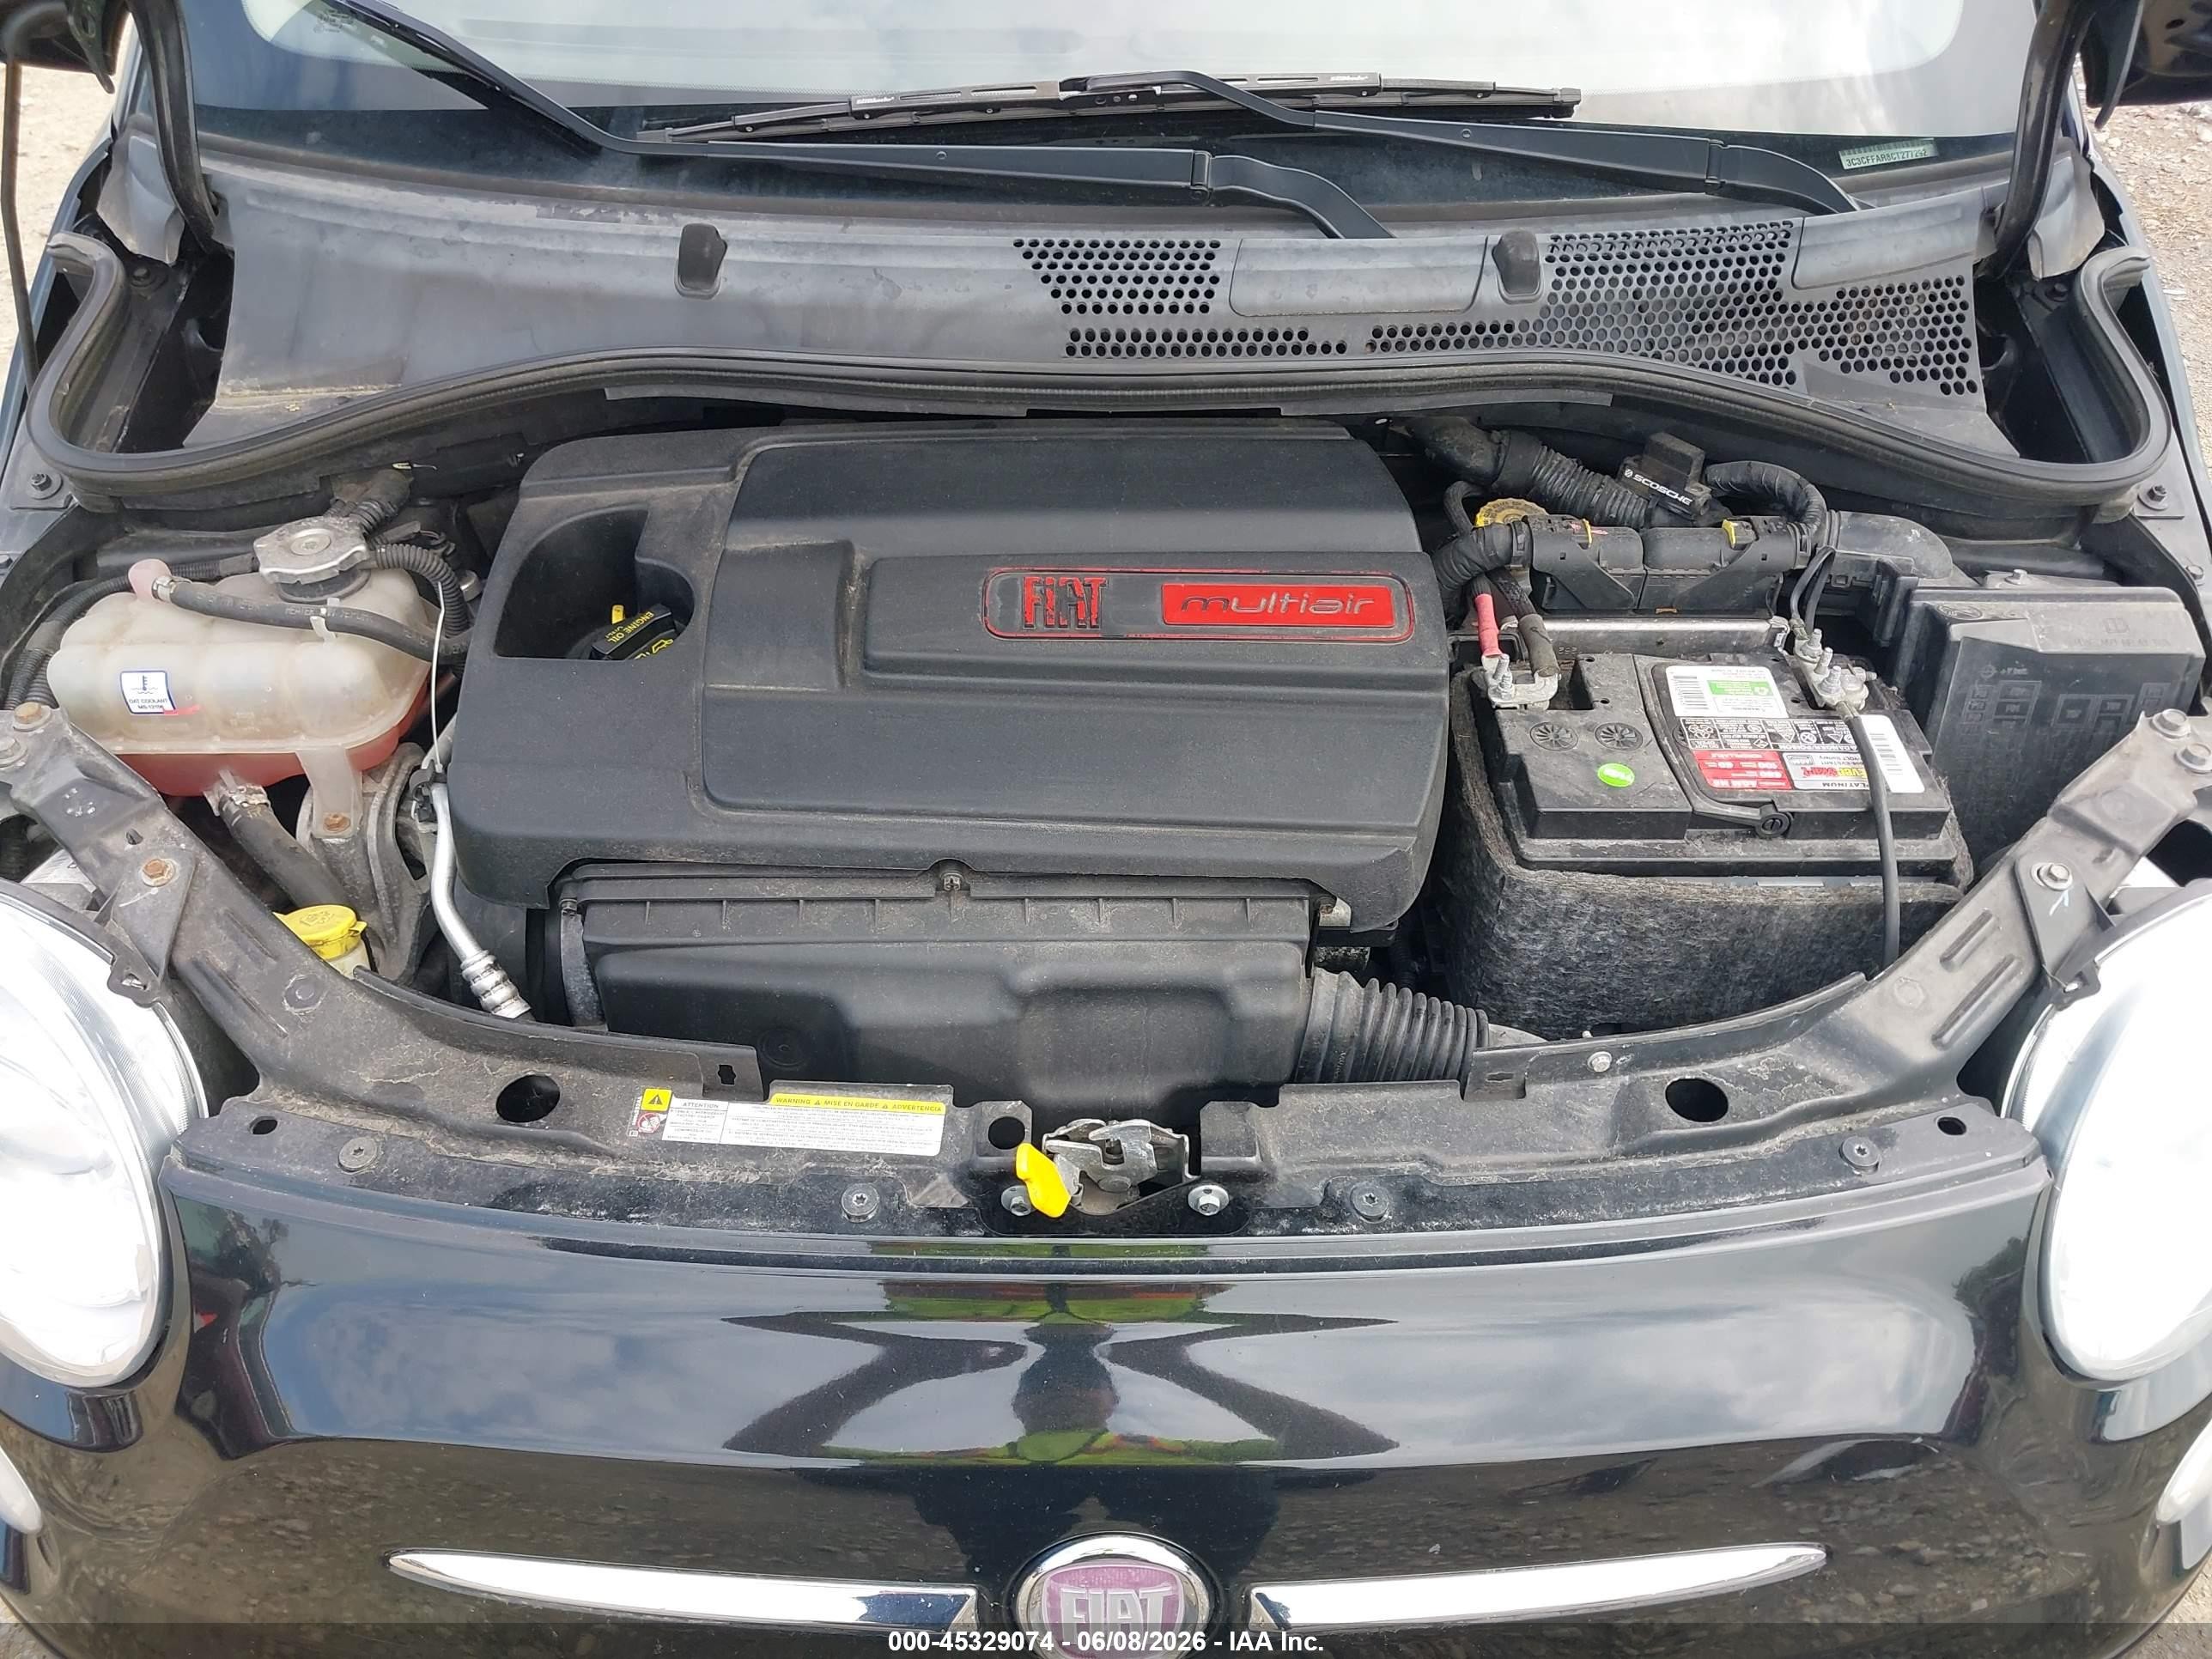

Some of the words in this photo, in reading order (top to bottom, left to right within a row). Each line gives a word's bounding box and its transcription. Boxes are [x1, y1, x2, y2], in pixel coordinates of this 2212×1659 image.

[1632, 473, 1693, 506] SCOSCHE
[1023, 576, 1108, 628] FIAT
[1181, 592, 1376, 616] multiair
[623, 611, 654, 634] ENGINE
[607, 632, 625, 643] OIL
[775, 1097, 811, 1105] WARNING
[891, 1103, 942, 1113] ADVERTENCIA
[1060, 1587, 1174, 1646] FIAT
